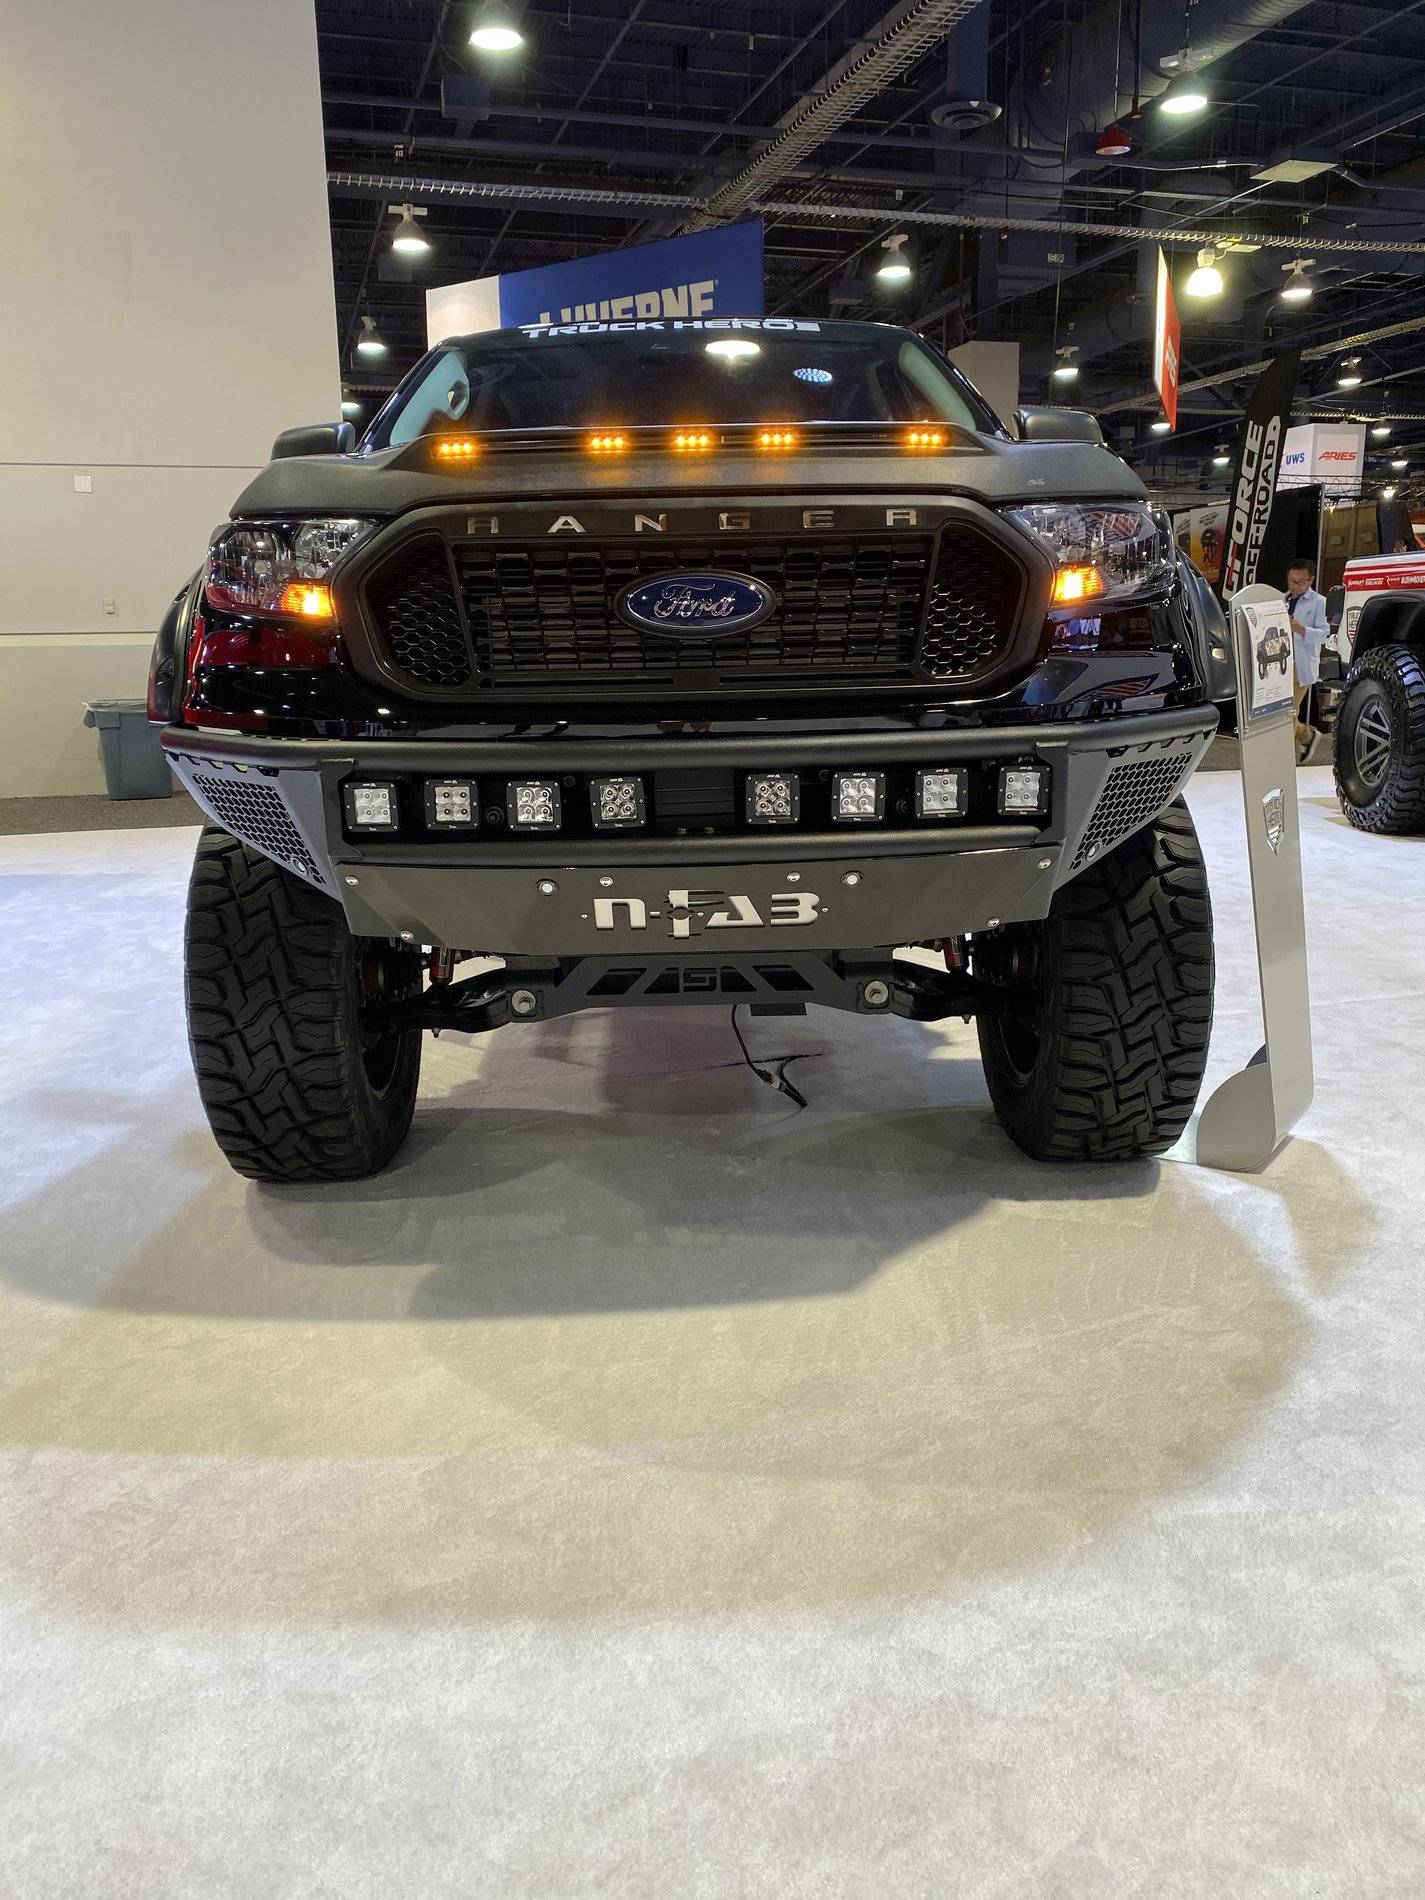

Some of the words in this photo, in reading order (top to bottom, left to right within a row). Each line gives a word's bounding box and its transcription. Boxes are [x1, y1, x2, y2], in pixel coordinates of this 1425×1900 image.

[522, 321, 665, 338] TRUCK
[1286, 453, 1305, 465] UWS
[1318, 451, 1357, 461] ARIES
[467, 507, 918, 535] RANGER
[654, 583, 735, 618] Ford
